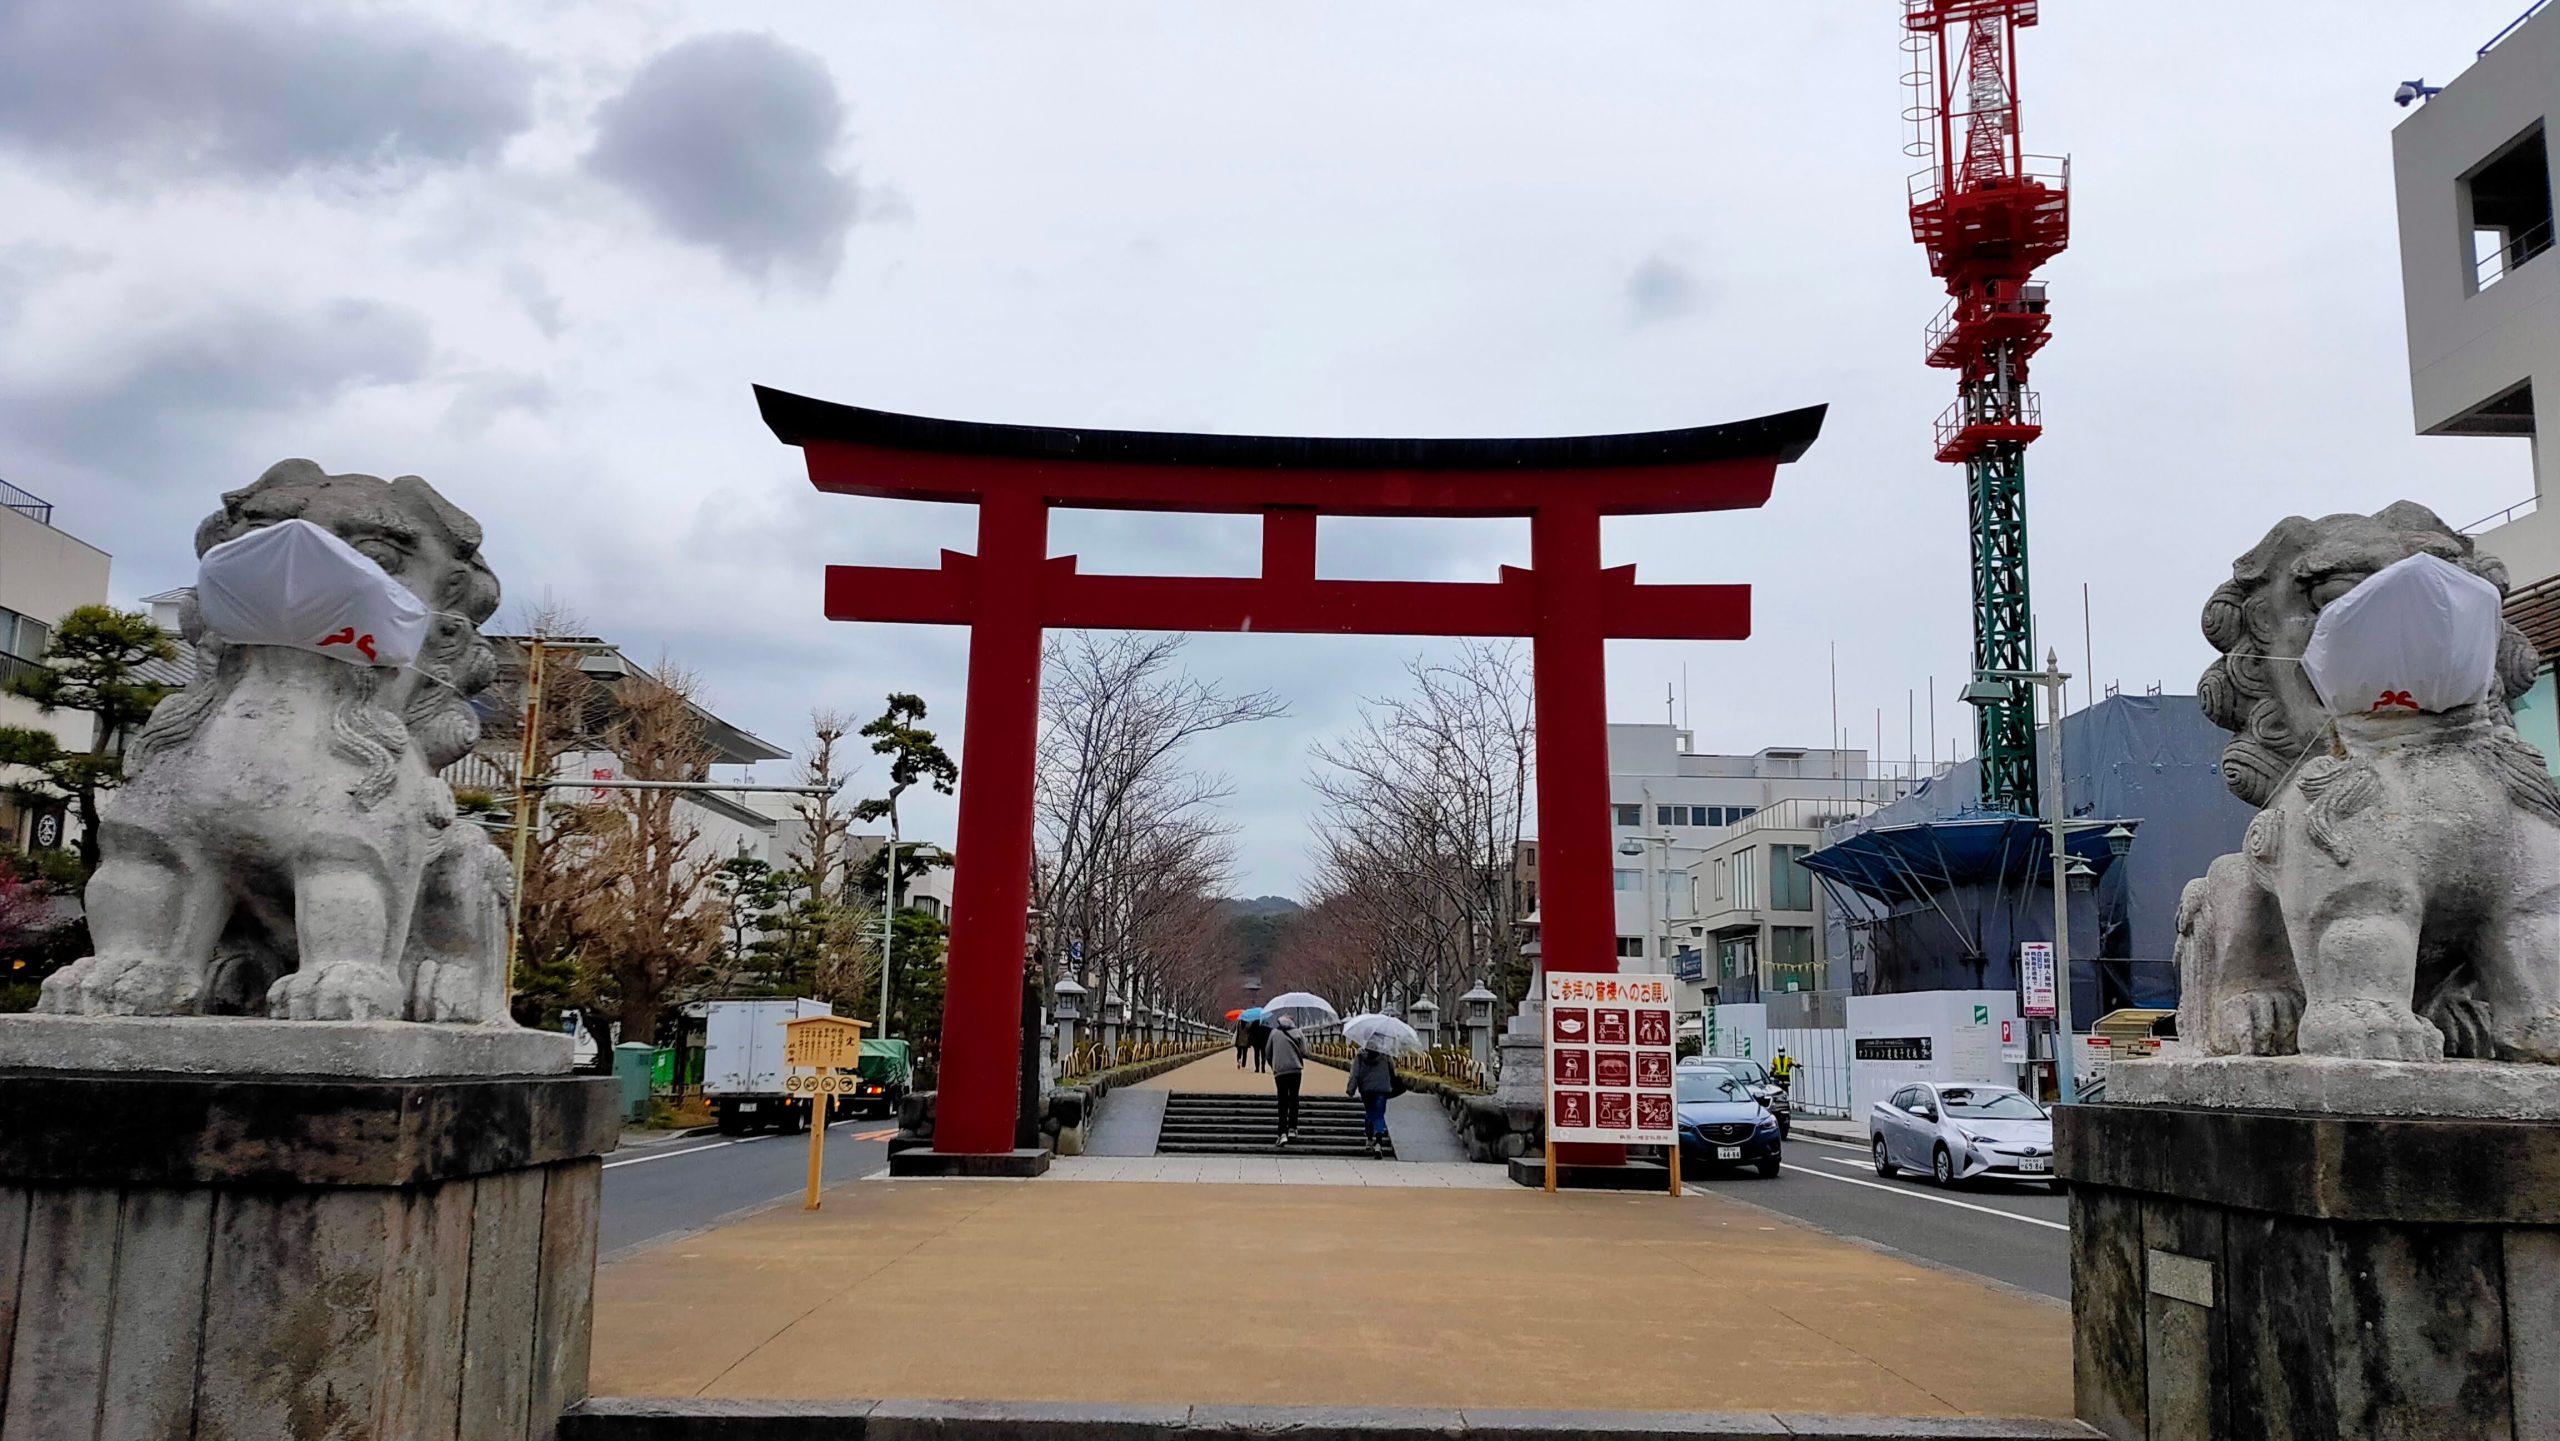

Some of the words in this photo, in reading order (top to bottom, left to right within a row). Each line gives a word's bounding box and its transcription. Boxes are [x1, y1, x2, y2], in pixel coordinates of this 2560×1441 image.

[1550, 977, 1673, 1004] ご参拝の皆様へのお願い
[2024, 951, 2032, 1006] 婦人服オーダー承ります
[2003, 1022, 2010, 1041] P
